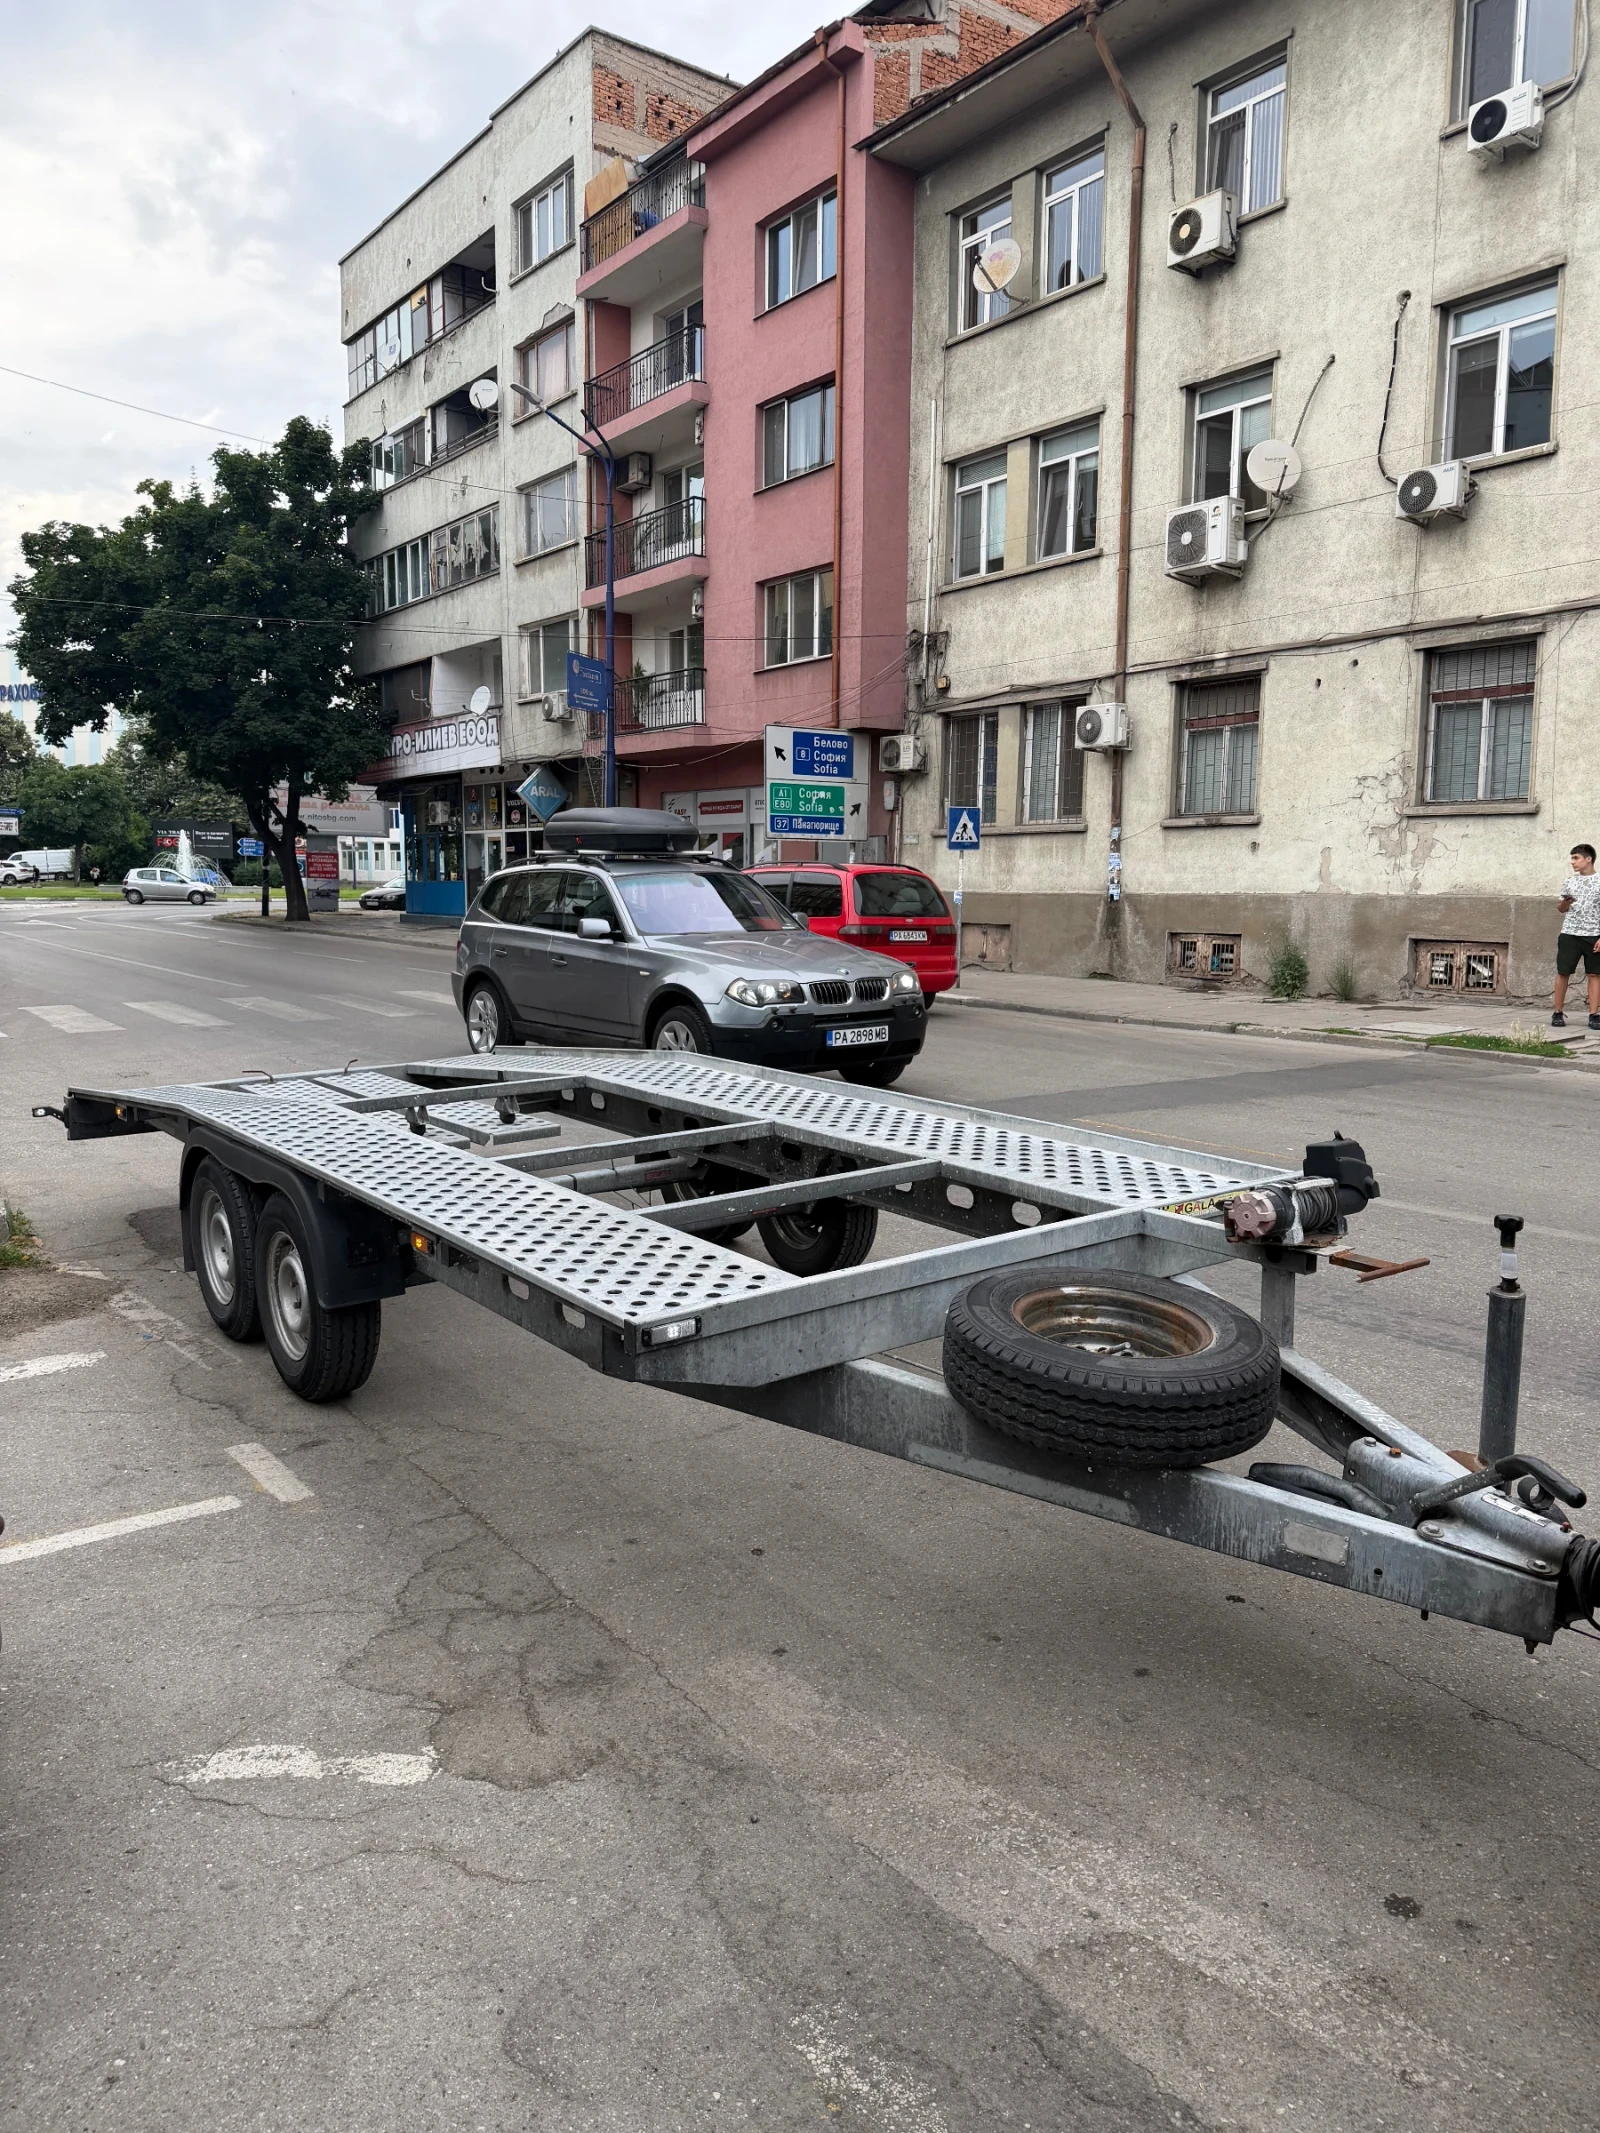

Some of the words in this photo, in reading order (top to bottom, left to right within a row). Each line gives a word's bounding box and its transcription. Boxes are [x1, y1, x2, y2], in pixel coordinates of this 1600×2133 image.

[0, 683, 46, 702] РАХОВ
[459, 716, 499, 747] ЕООД
[813, 737, 848, 749] Белово
[800, 750, 806, 758] 8
[813, 750, 847, 763] София
[813, 763, 838, 774] Sofia
[530, 786, 560, 797] ARAL
[779, 789, 787, 797] A1
[774, 799, 790, 808] E80
[799, 801, 823, 812] Sofia
[299, 813, 357, 822] w.nitosbg.com
[776, 820, 787, 828] 37
[792, 818, 840, 831] Панагюрище
